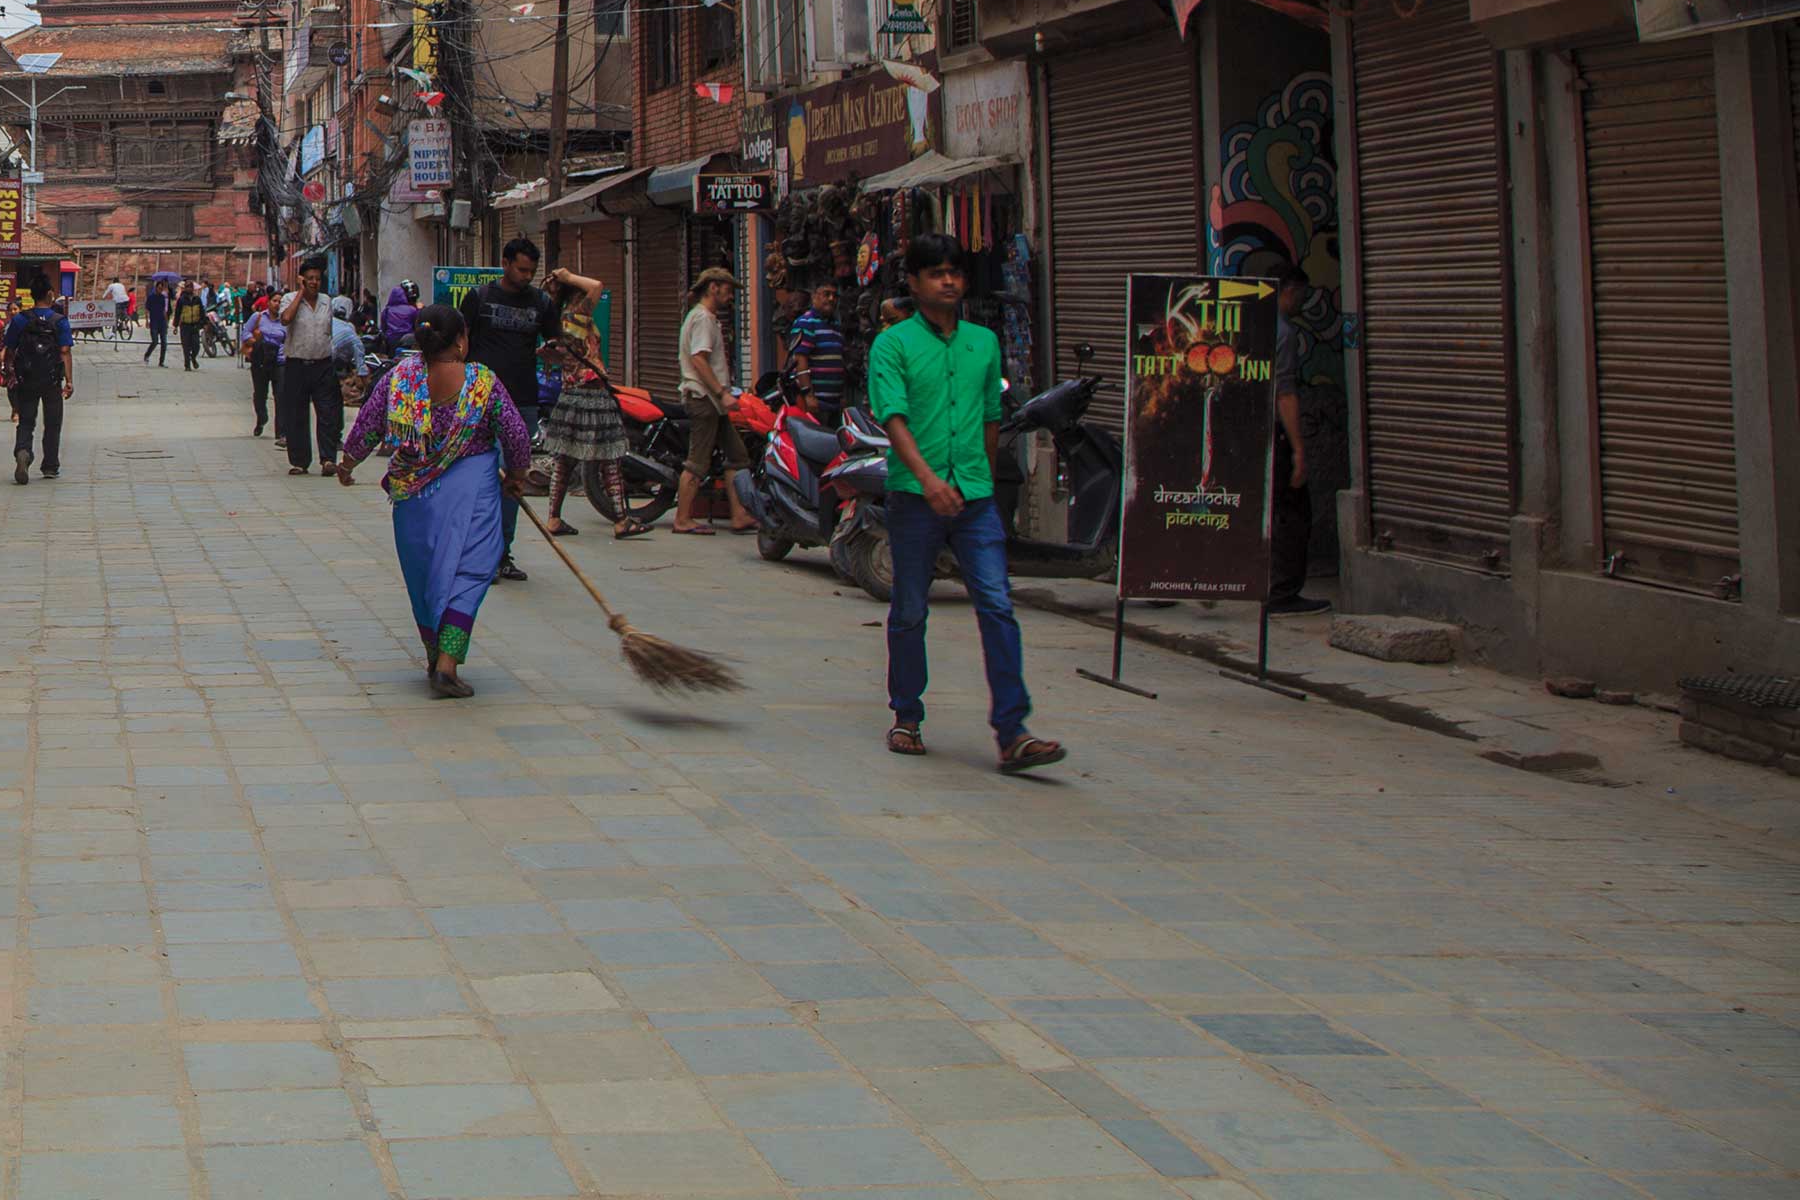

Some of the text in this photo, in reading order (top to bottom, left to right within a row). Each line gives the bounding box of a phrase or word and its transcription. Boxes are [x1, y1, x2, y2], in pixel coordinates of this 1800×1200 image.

[805, 99, 841, 143] TIBETAN
[842, 91, 867, 136] MASK
[867, 83, 906, 128] CENTRE
[742, 134, 773, 163] Lodge
[413, 161, 449, 170] GUEST
[413, 172, 451, 182] HOUSE
[707, 184, 763, 200] TATTOO
[1152, 483, 1241, 508] dreadlocks
[1165, 507, 1230, 531] piercing
[1193, 582, 1218, 592] FREAK
[1219, 583, 1247, 593] STREET
